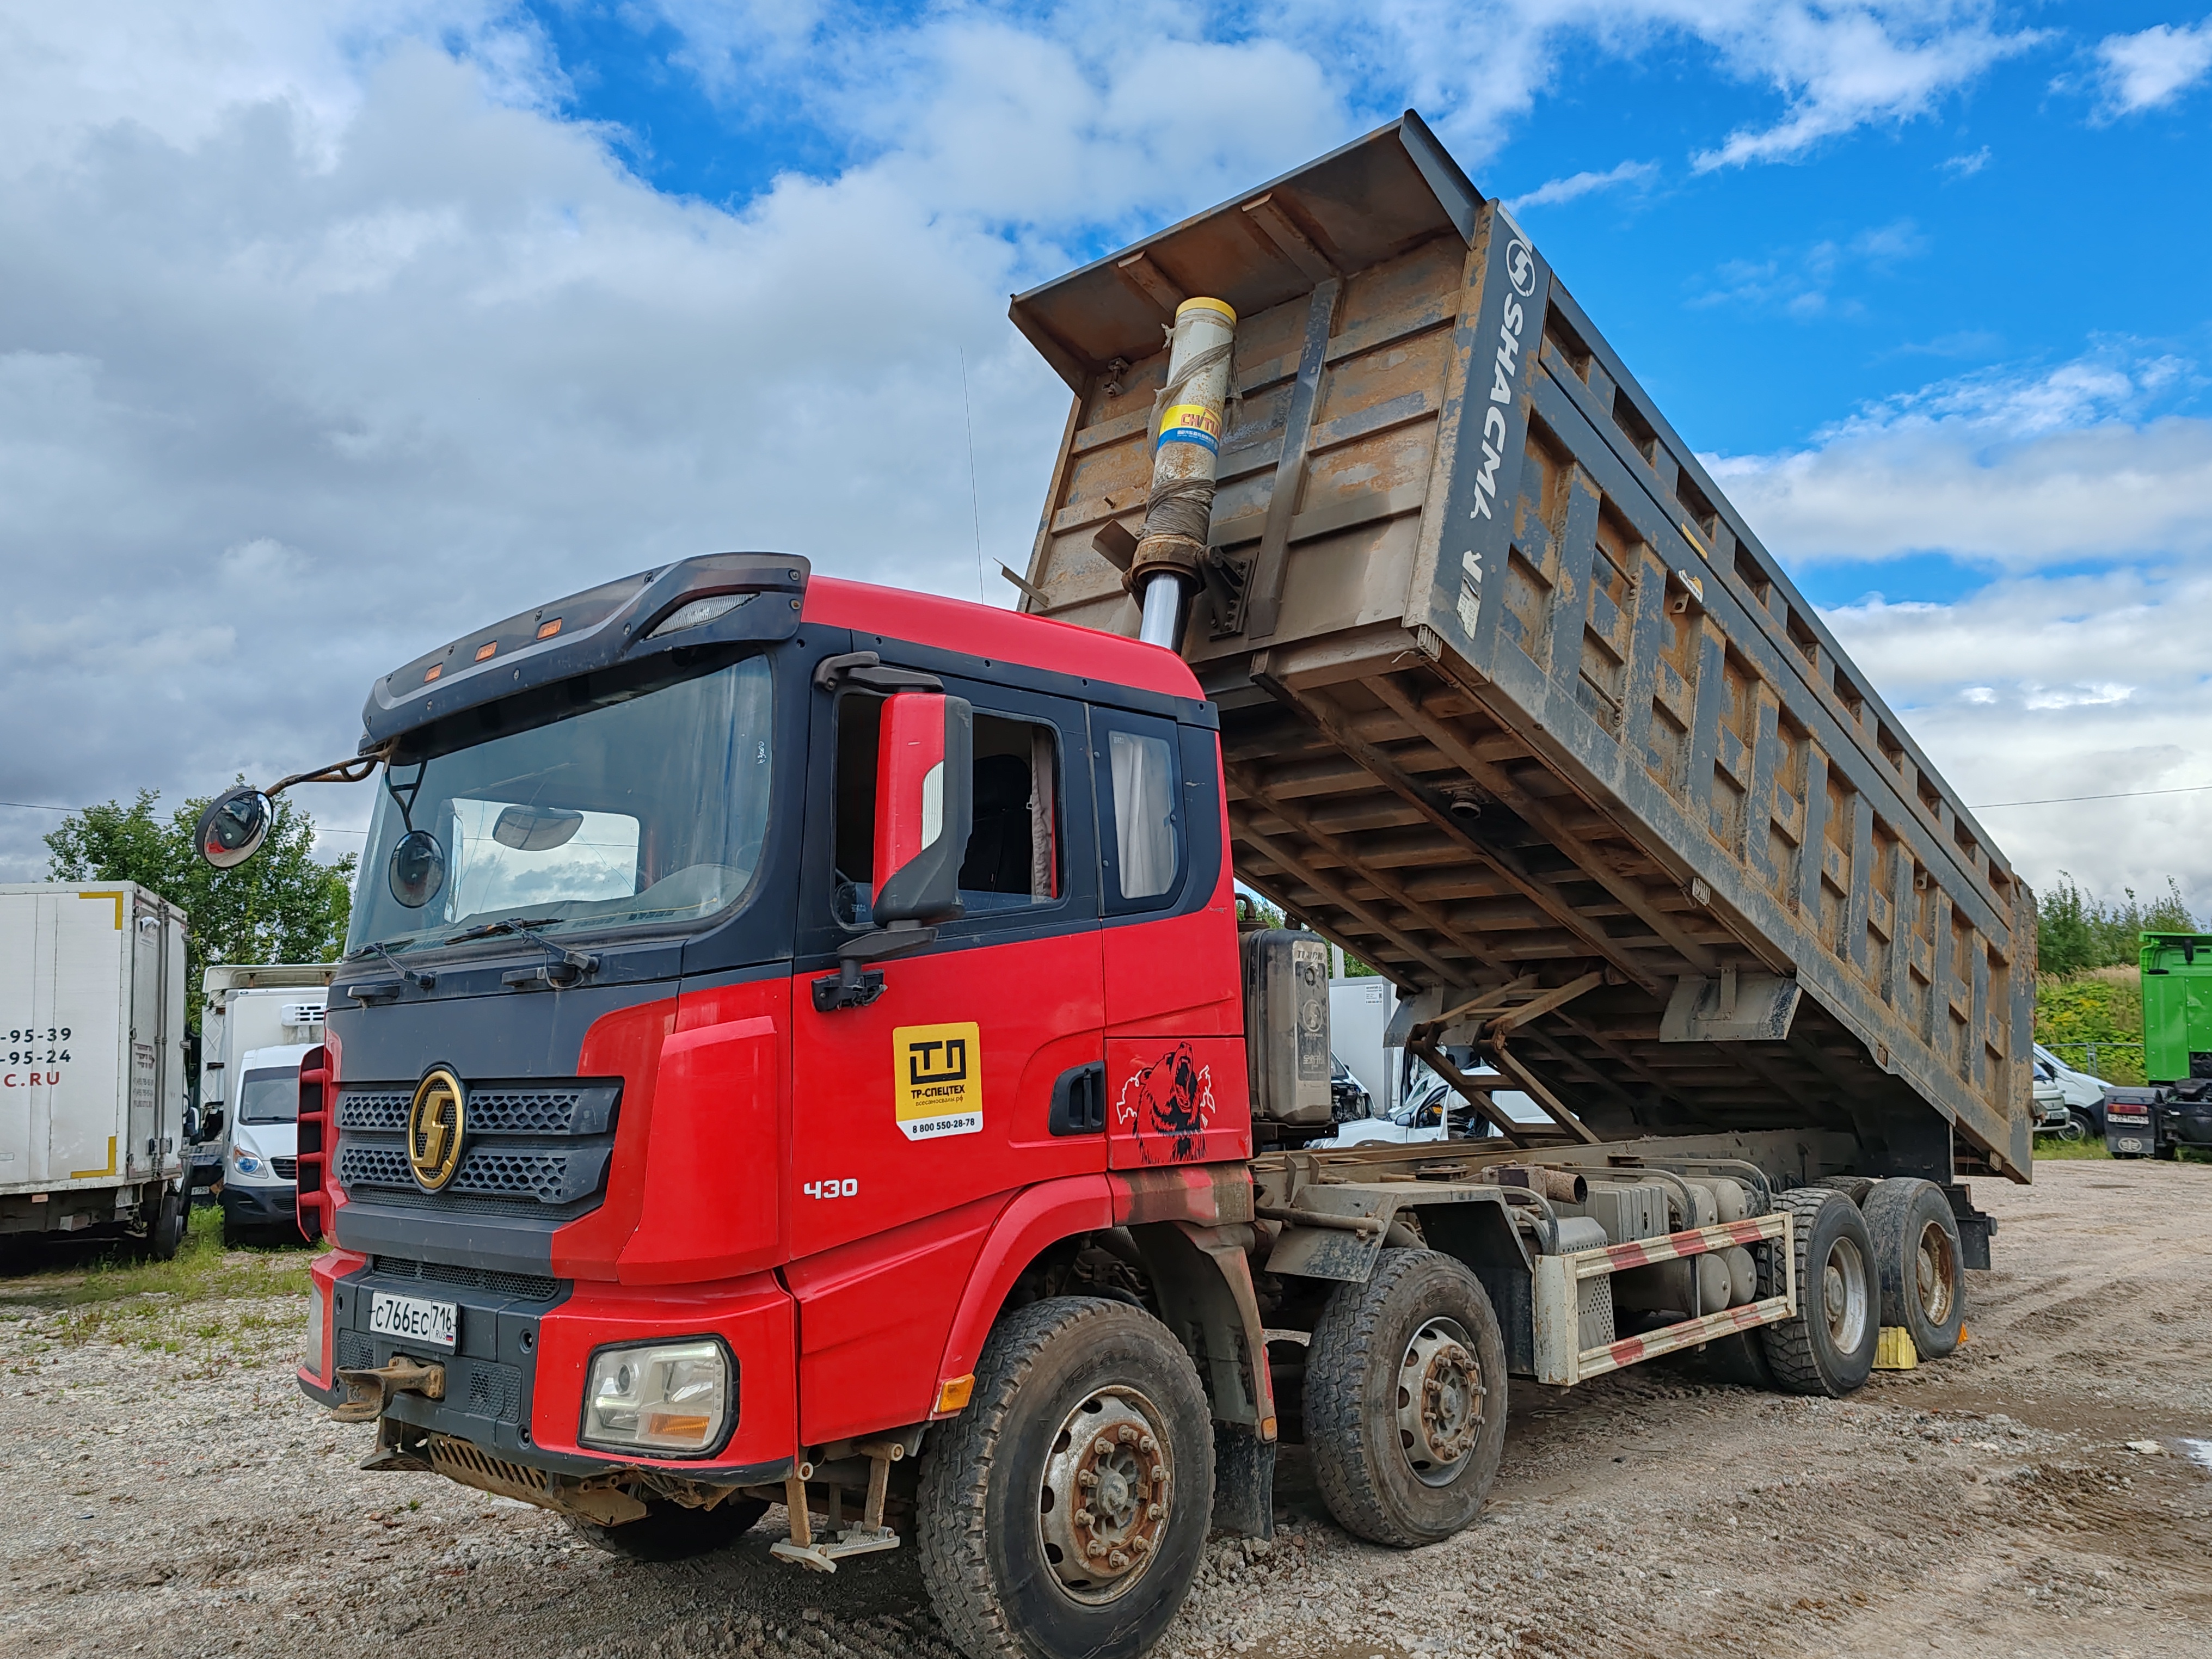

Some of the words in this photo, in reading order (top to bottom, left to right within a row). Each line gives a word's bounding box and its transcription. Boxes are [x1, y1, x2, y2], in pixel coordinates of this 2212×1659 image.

[911, 1084, 966, 1099] ТР-СПЕЦТЕХ
[912, 1125, 917, 1134] 8
[919, 1123, 934, 1133] 800
[936, 1118, 975, 1130] 550-28-78
[803, 1178, 858, 1200] 430
[432, 1305, 452, 1331] 716
[435, 1330, 446, 1340] RUS
